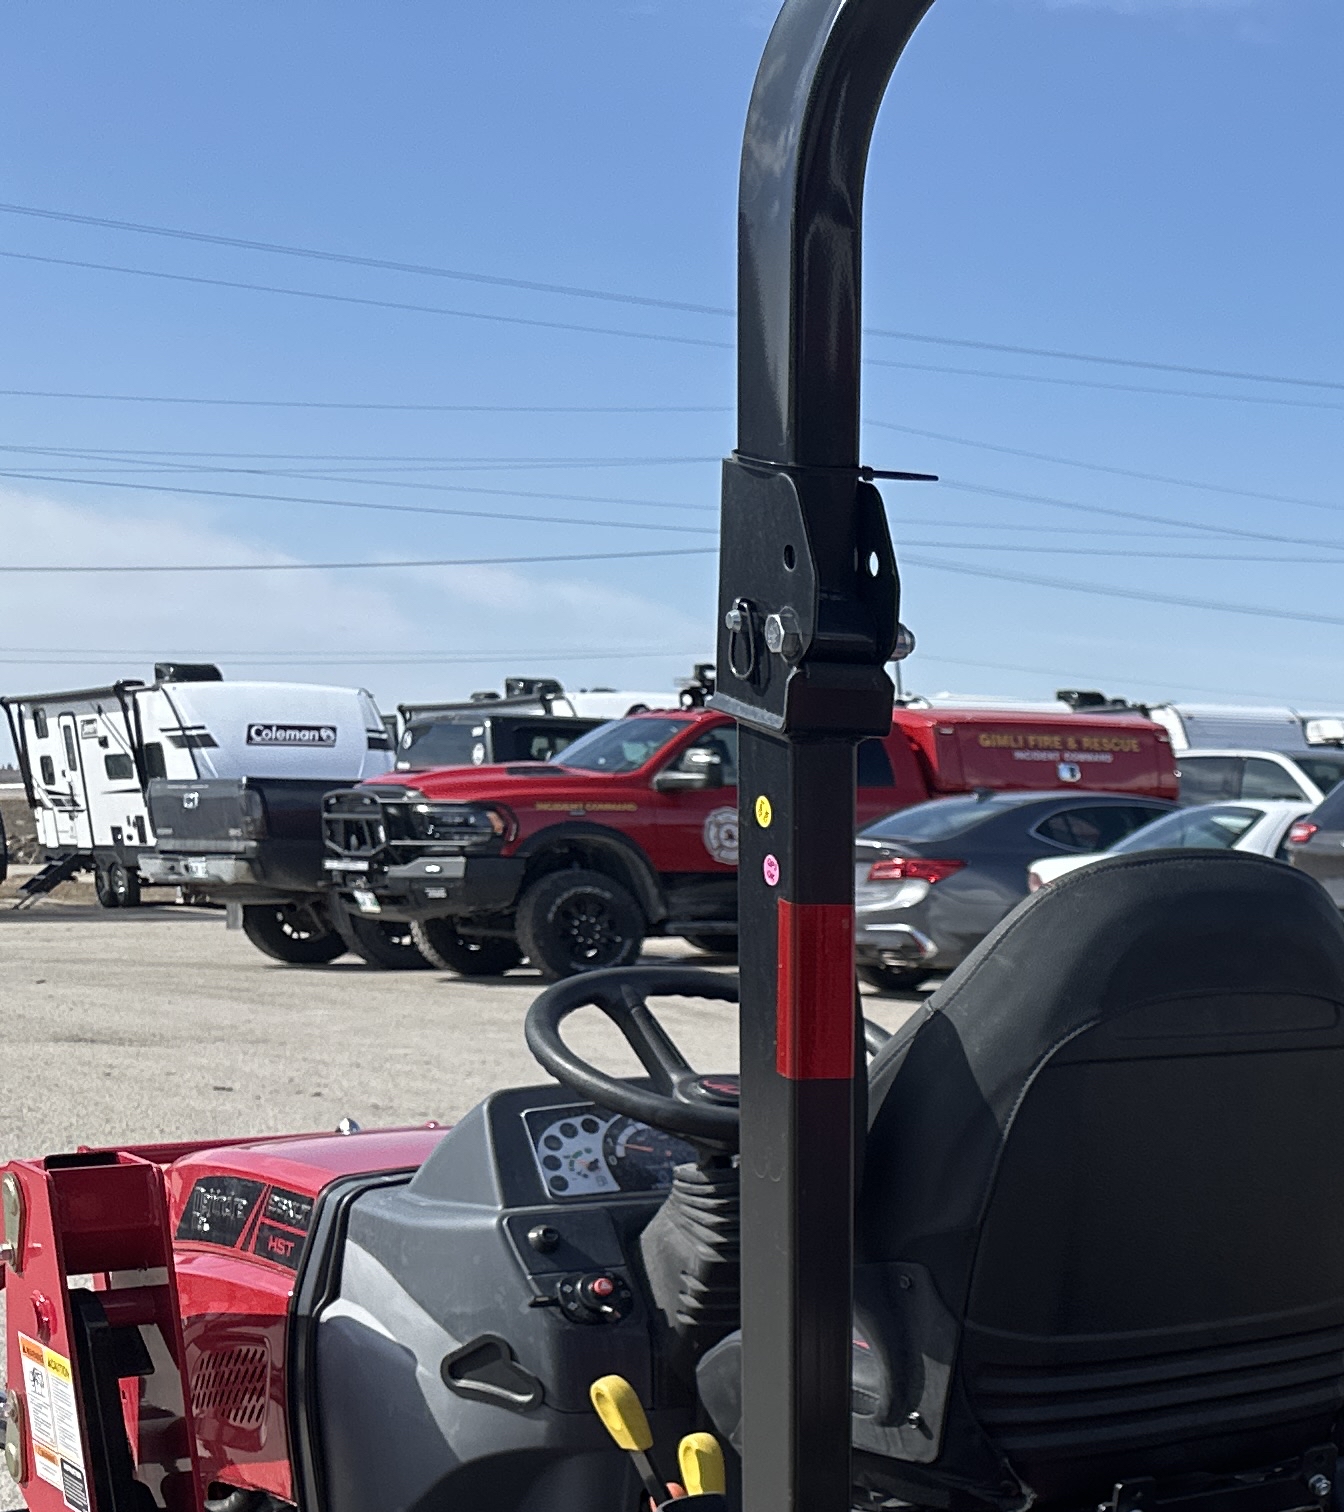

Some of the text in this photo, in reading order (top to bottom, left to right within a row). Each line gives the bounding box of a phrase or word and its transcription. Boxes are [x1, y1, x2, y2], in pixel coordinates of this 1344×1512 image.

[250, 725, 320, 742] Coleman
[1027, 736, 1062, 750] FIRE
[1067, 737, 1078, 750] &
[1081, 738, 1140, 752] RESCUE
[268, 1235, 295, 1258] HST
